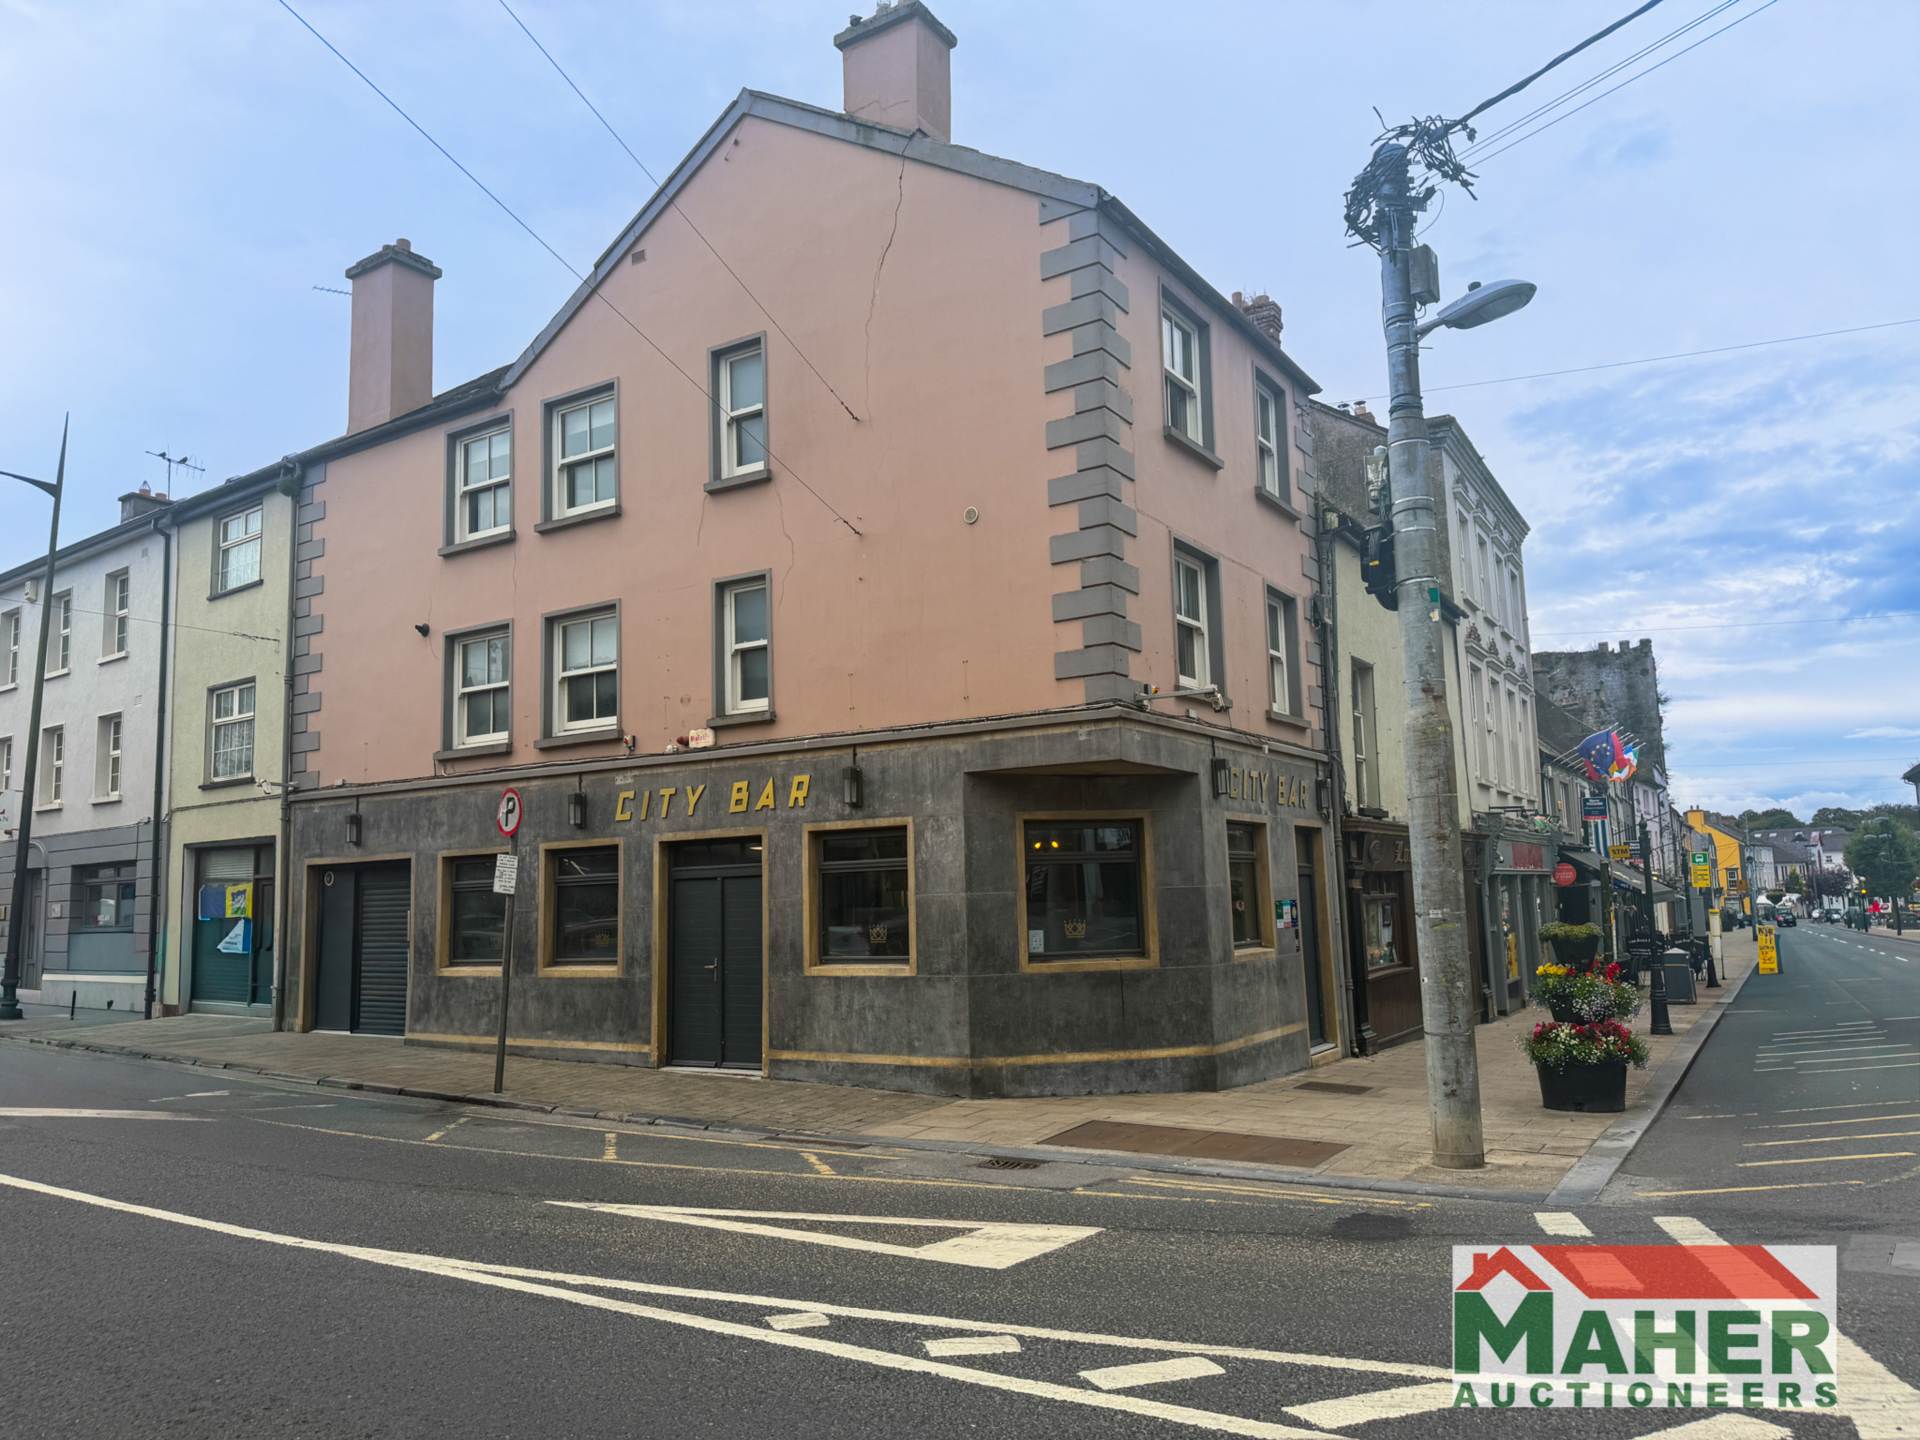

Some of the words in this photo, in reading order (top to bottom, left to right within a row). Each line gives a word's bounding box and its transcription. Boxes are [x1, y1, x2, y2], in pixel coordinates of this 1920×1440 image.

[615, 783, 706, 822] CITY
[728, 774, 811, 814] BAR
[1230, 767, 1270, 804] CITY
[1278, 775, 1309, 810] BAR
[505, 796, 516, 827] P
